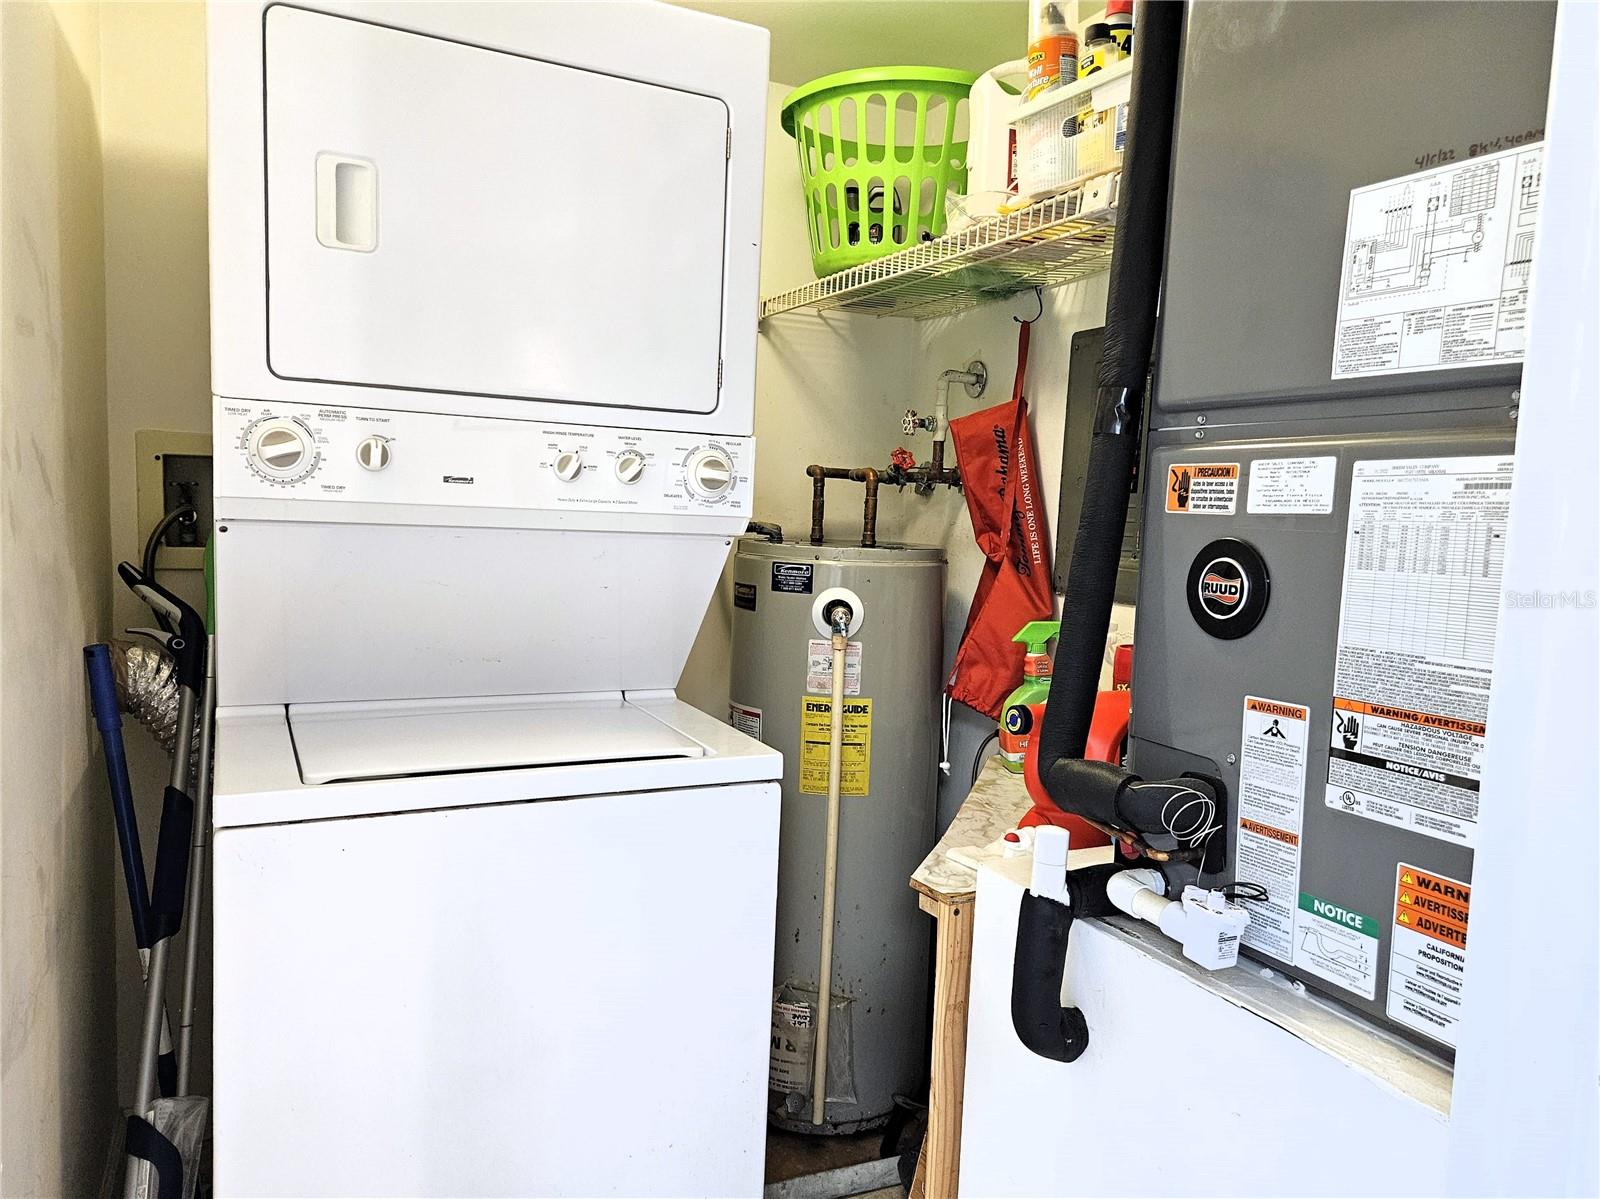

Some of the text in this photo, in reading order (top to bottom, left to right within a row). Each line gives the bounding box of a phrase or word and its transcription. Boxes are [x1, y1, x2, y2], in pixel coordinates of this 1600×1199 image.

[1022, 483, 1034, 509] LONG
[1026, 509, 1036, 531] ONE
[1029, 531, 1038, 541] IS
[1030, 542, 1042, 565] LIFE
[1203, 582, 1239, 595] RUUD
[1257, 702, 1302, 719] WARNING
[1401, 723, 1473, 741] HAZARDOUS VOLTAGE
[1399, 742, 1471, 763] TENSION DANGEREUSE
[1386, 761, 1446, 782] NOTICE/AVIS
[1248, 822, 1299, 846] AVERTISSEMENT
[1416, 876, 1469, 903] WARN
[1314, 899, 1363, 929] NOTICE
[1416, 917, 1467, 945] ADVERTE
[1418, 949, 1463, 973] PROPOSITION
